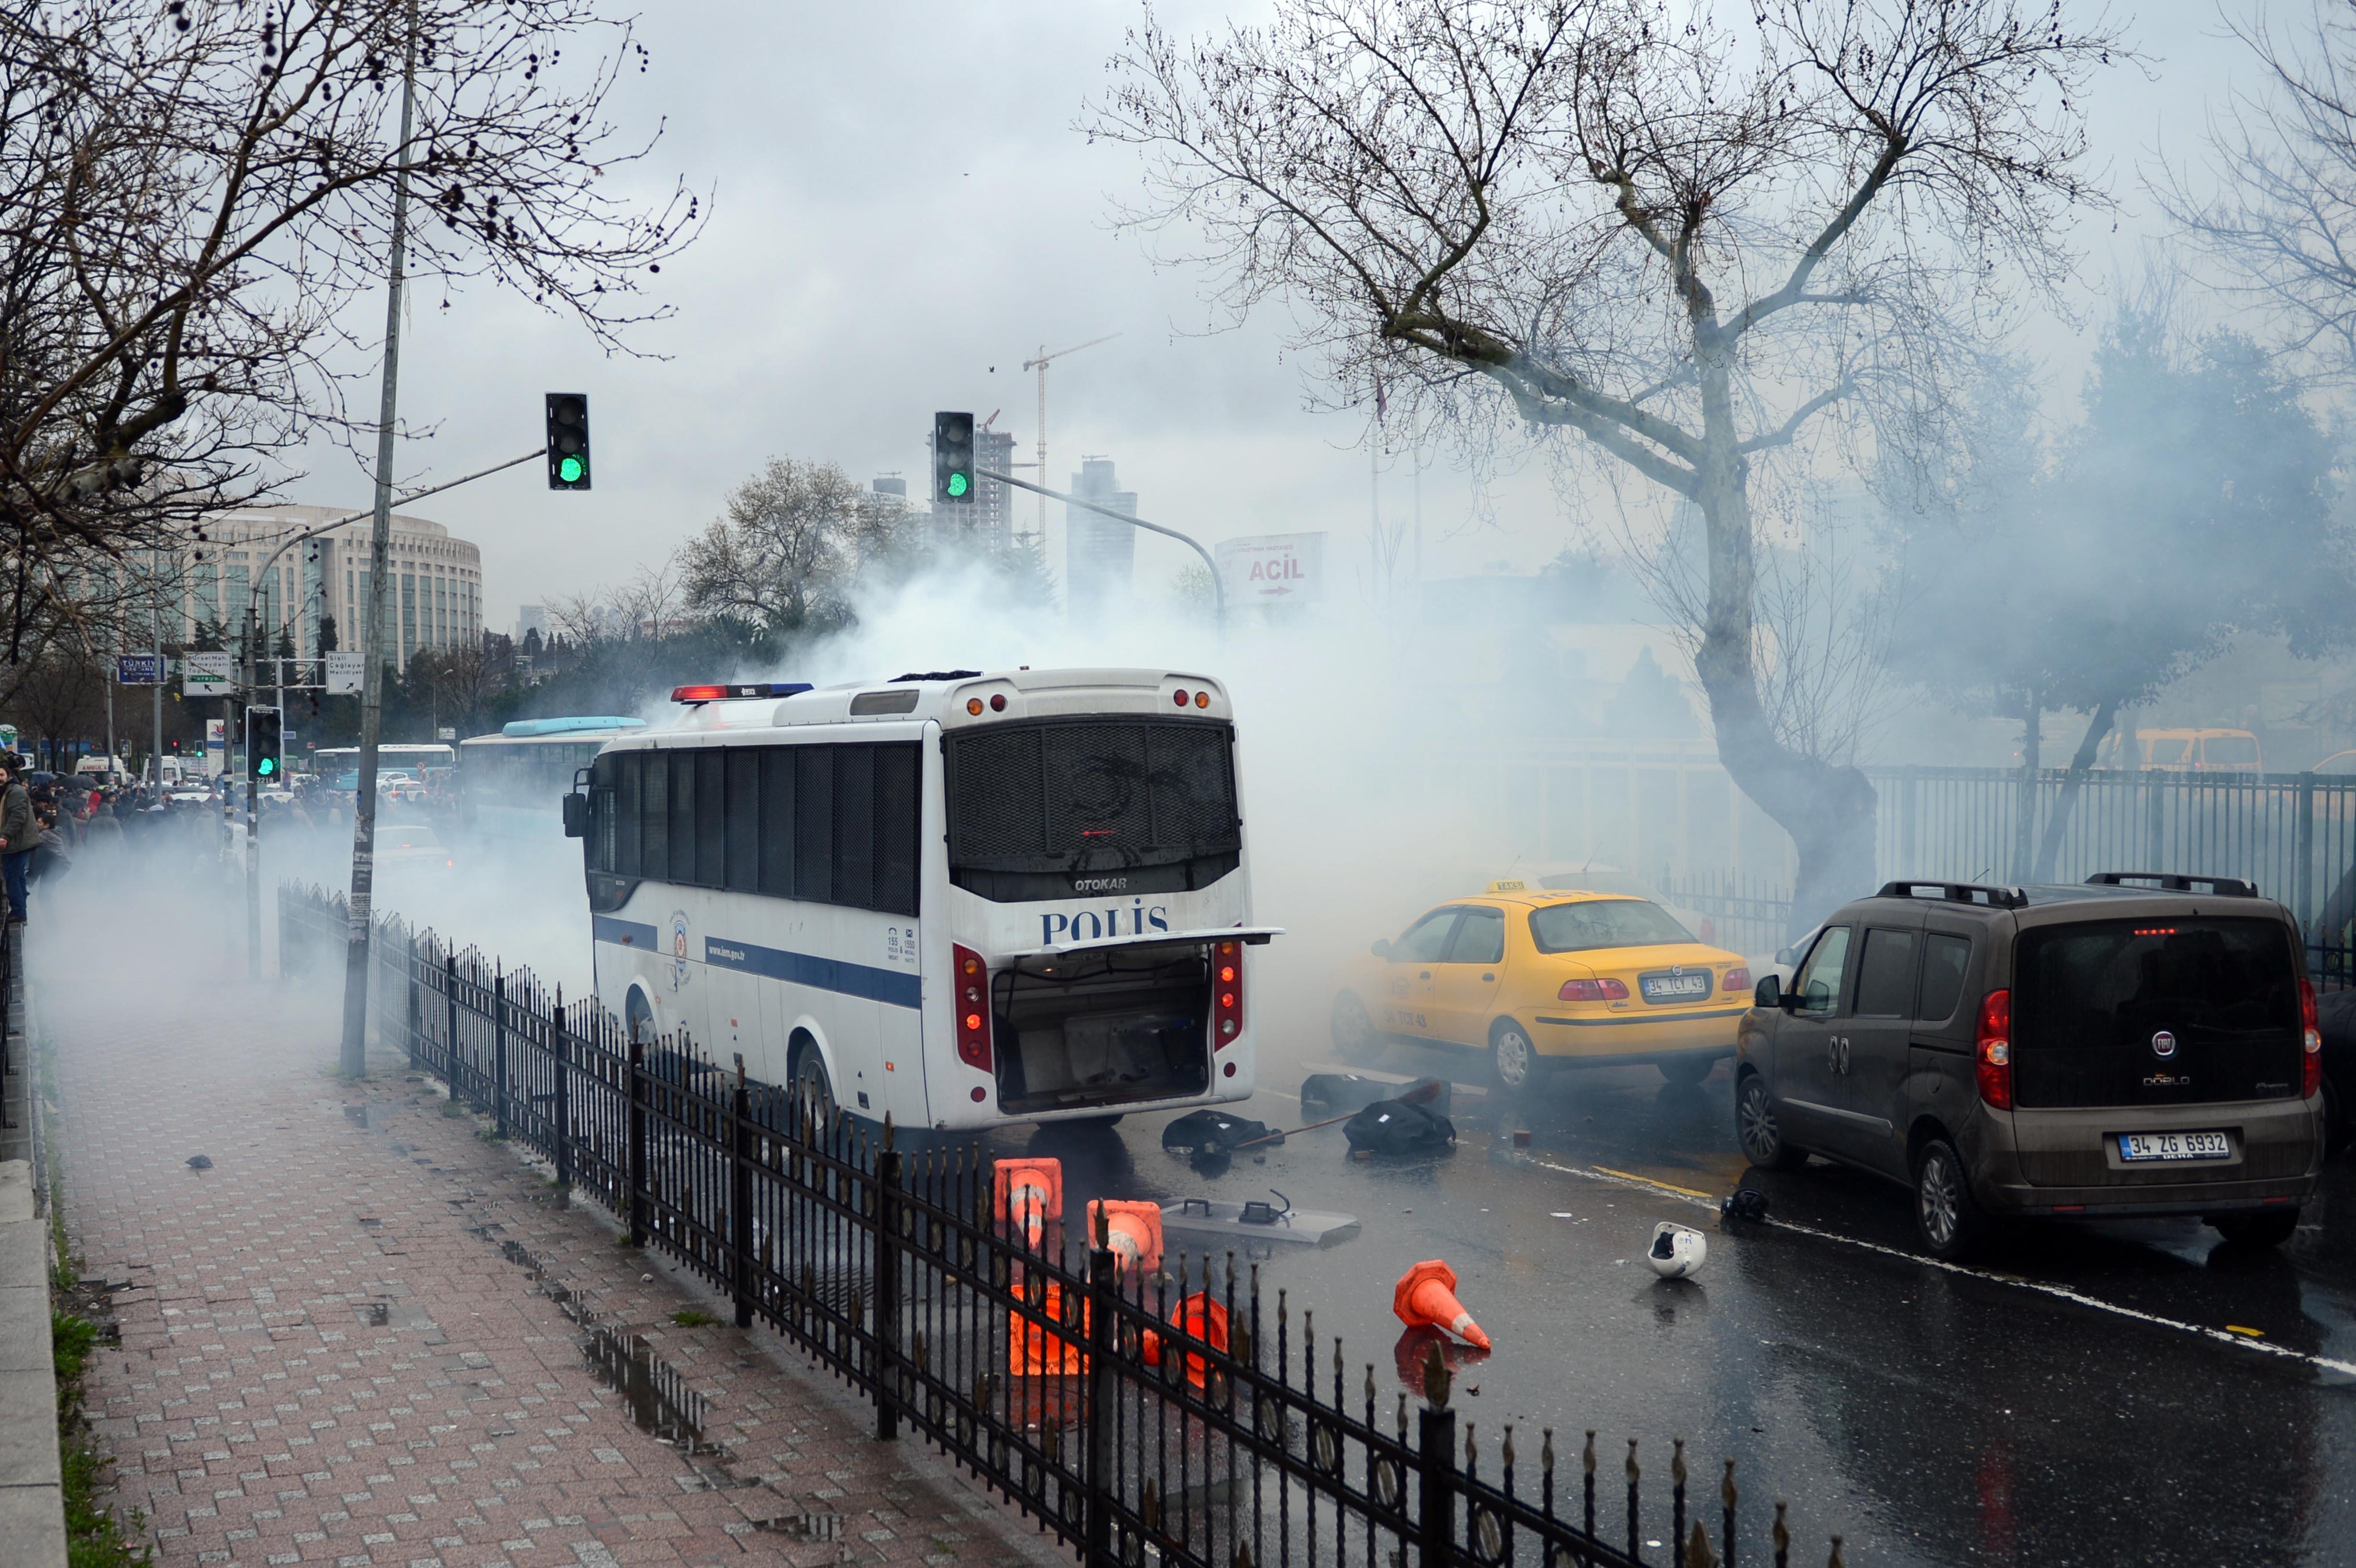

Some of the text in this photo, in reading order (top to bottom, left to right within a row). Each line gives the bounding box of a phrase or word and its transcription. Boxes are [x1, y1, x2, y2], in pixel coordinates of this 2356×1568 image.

[1249, 553, 1305, 581] ACİL
[1075, 878, 1127, 891] OTOKAR
[1039, 897, 1168, 946] POLİS
[888, 937, 898, 946] 155
[905, 940, 915, 949] 1550
[1649, 977, 1703, 991] 34 TCY 43
[1417, 1014, 1427, 1028] 43
[2158, 1038, 2171, 1050] FIAT
[2131, 1134, 2225, 1154] 34 ZG 6932
